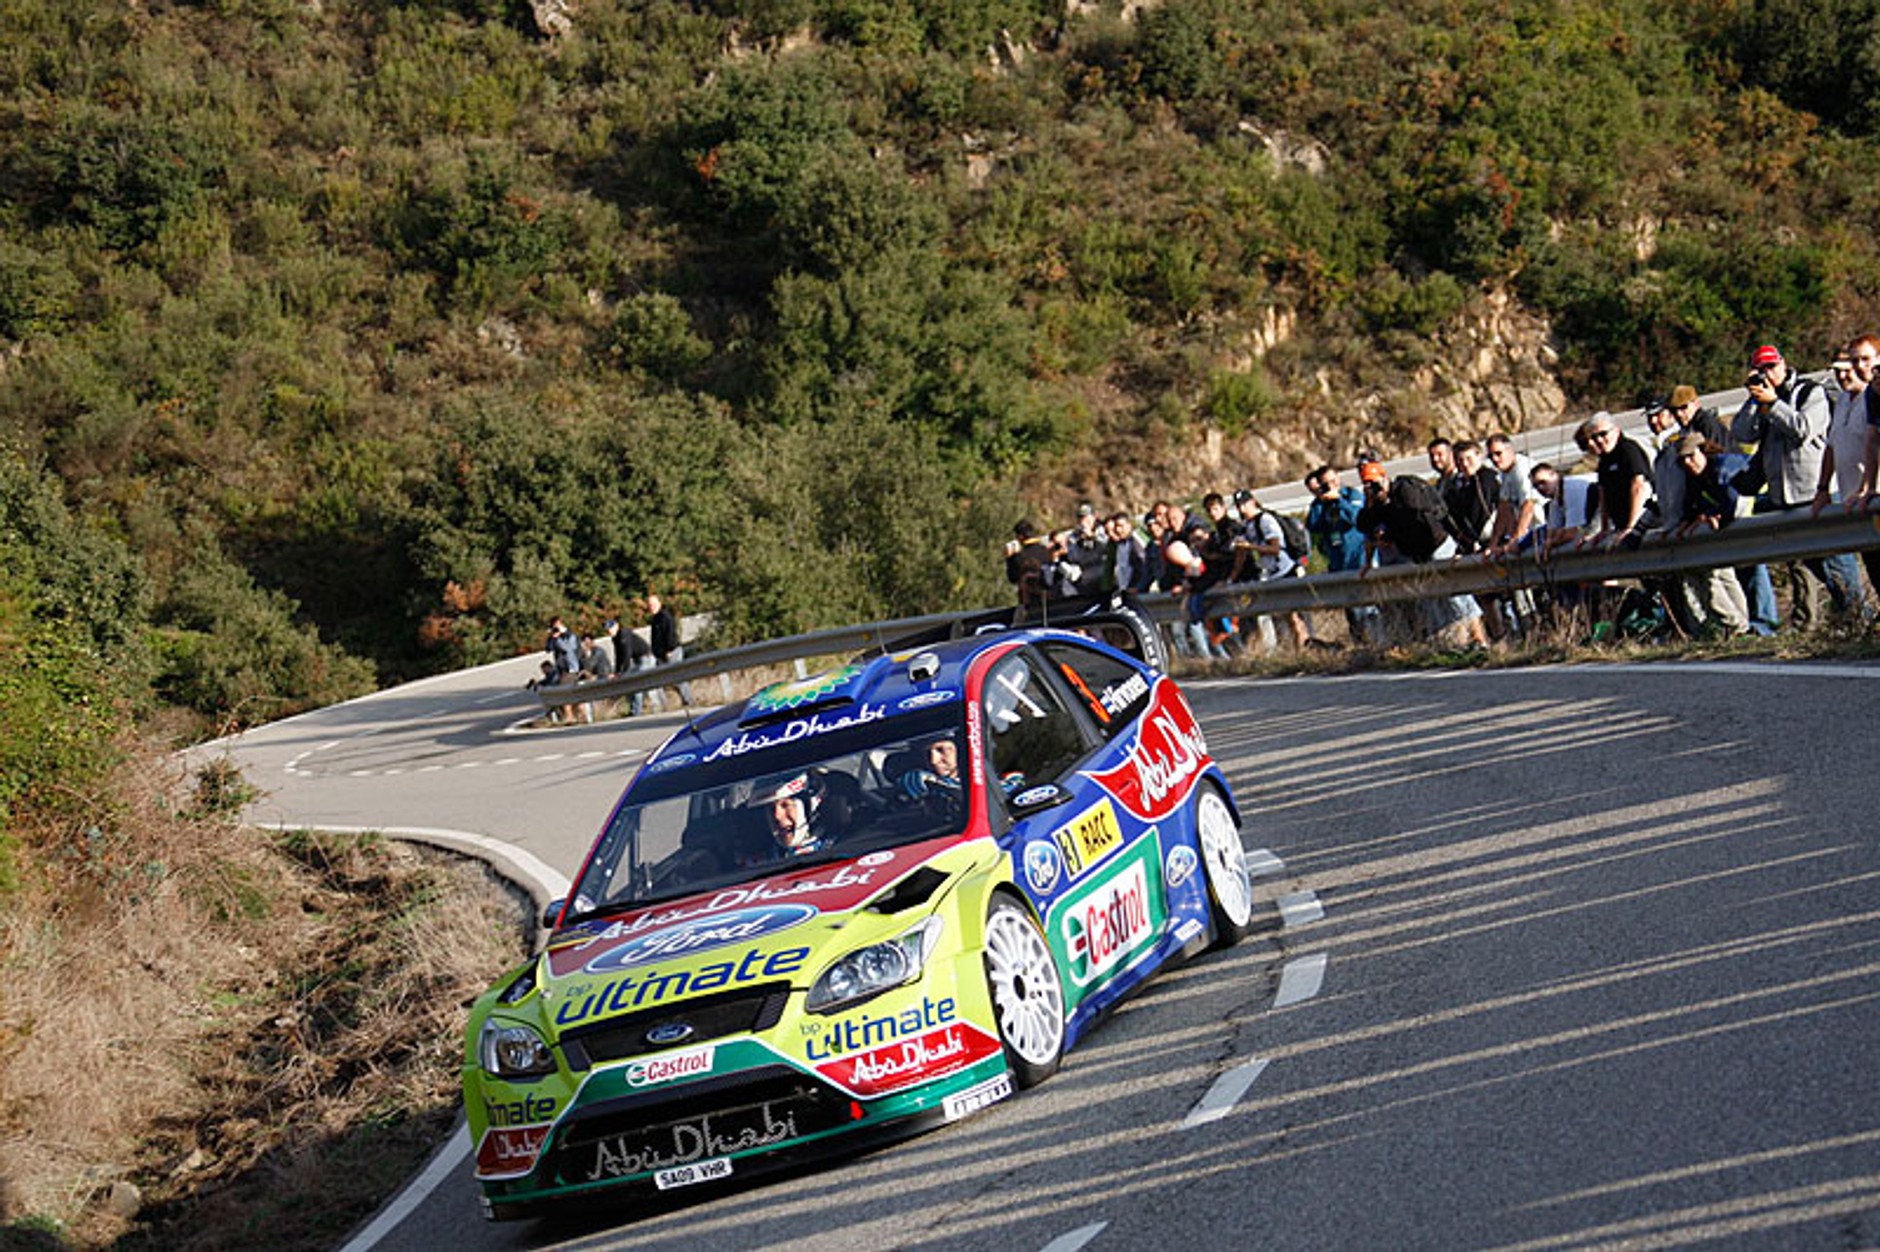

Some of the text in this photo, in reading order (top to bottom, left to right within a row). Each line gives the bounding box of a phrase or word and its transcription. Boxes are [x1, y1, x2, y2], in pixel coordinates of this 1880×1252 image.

[702, 702, 887, 763] Abu Dhabi
[1080, 811, 1113, 856] RACC
[573, 911, 690, 951] Abu
[702, 866, 876, 914] Dhabi
[620, 913, 776, 964] Ford
[1086, 873, 1146, 964] Castrol
[556, 946, 811, 1026] ultimate
[806, 996, 956, 1061] ultimate
[899, 1027, 965, 1071] Dhabi
[648, 1052, 708, 1081] Castrol
[587, 1102, 799, 1180] Abu Dhabi
